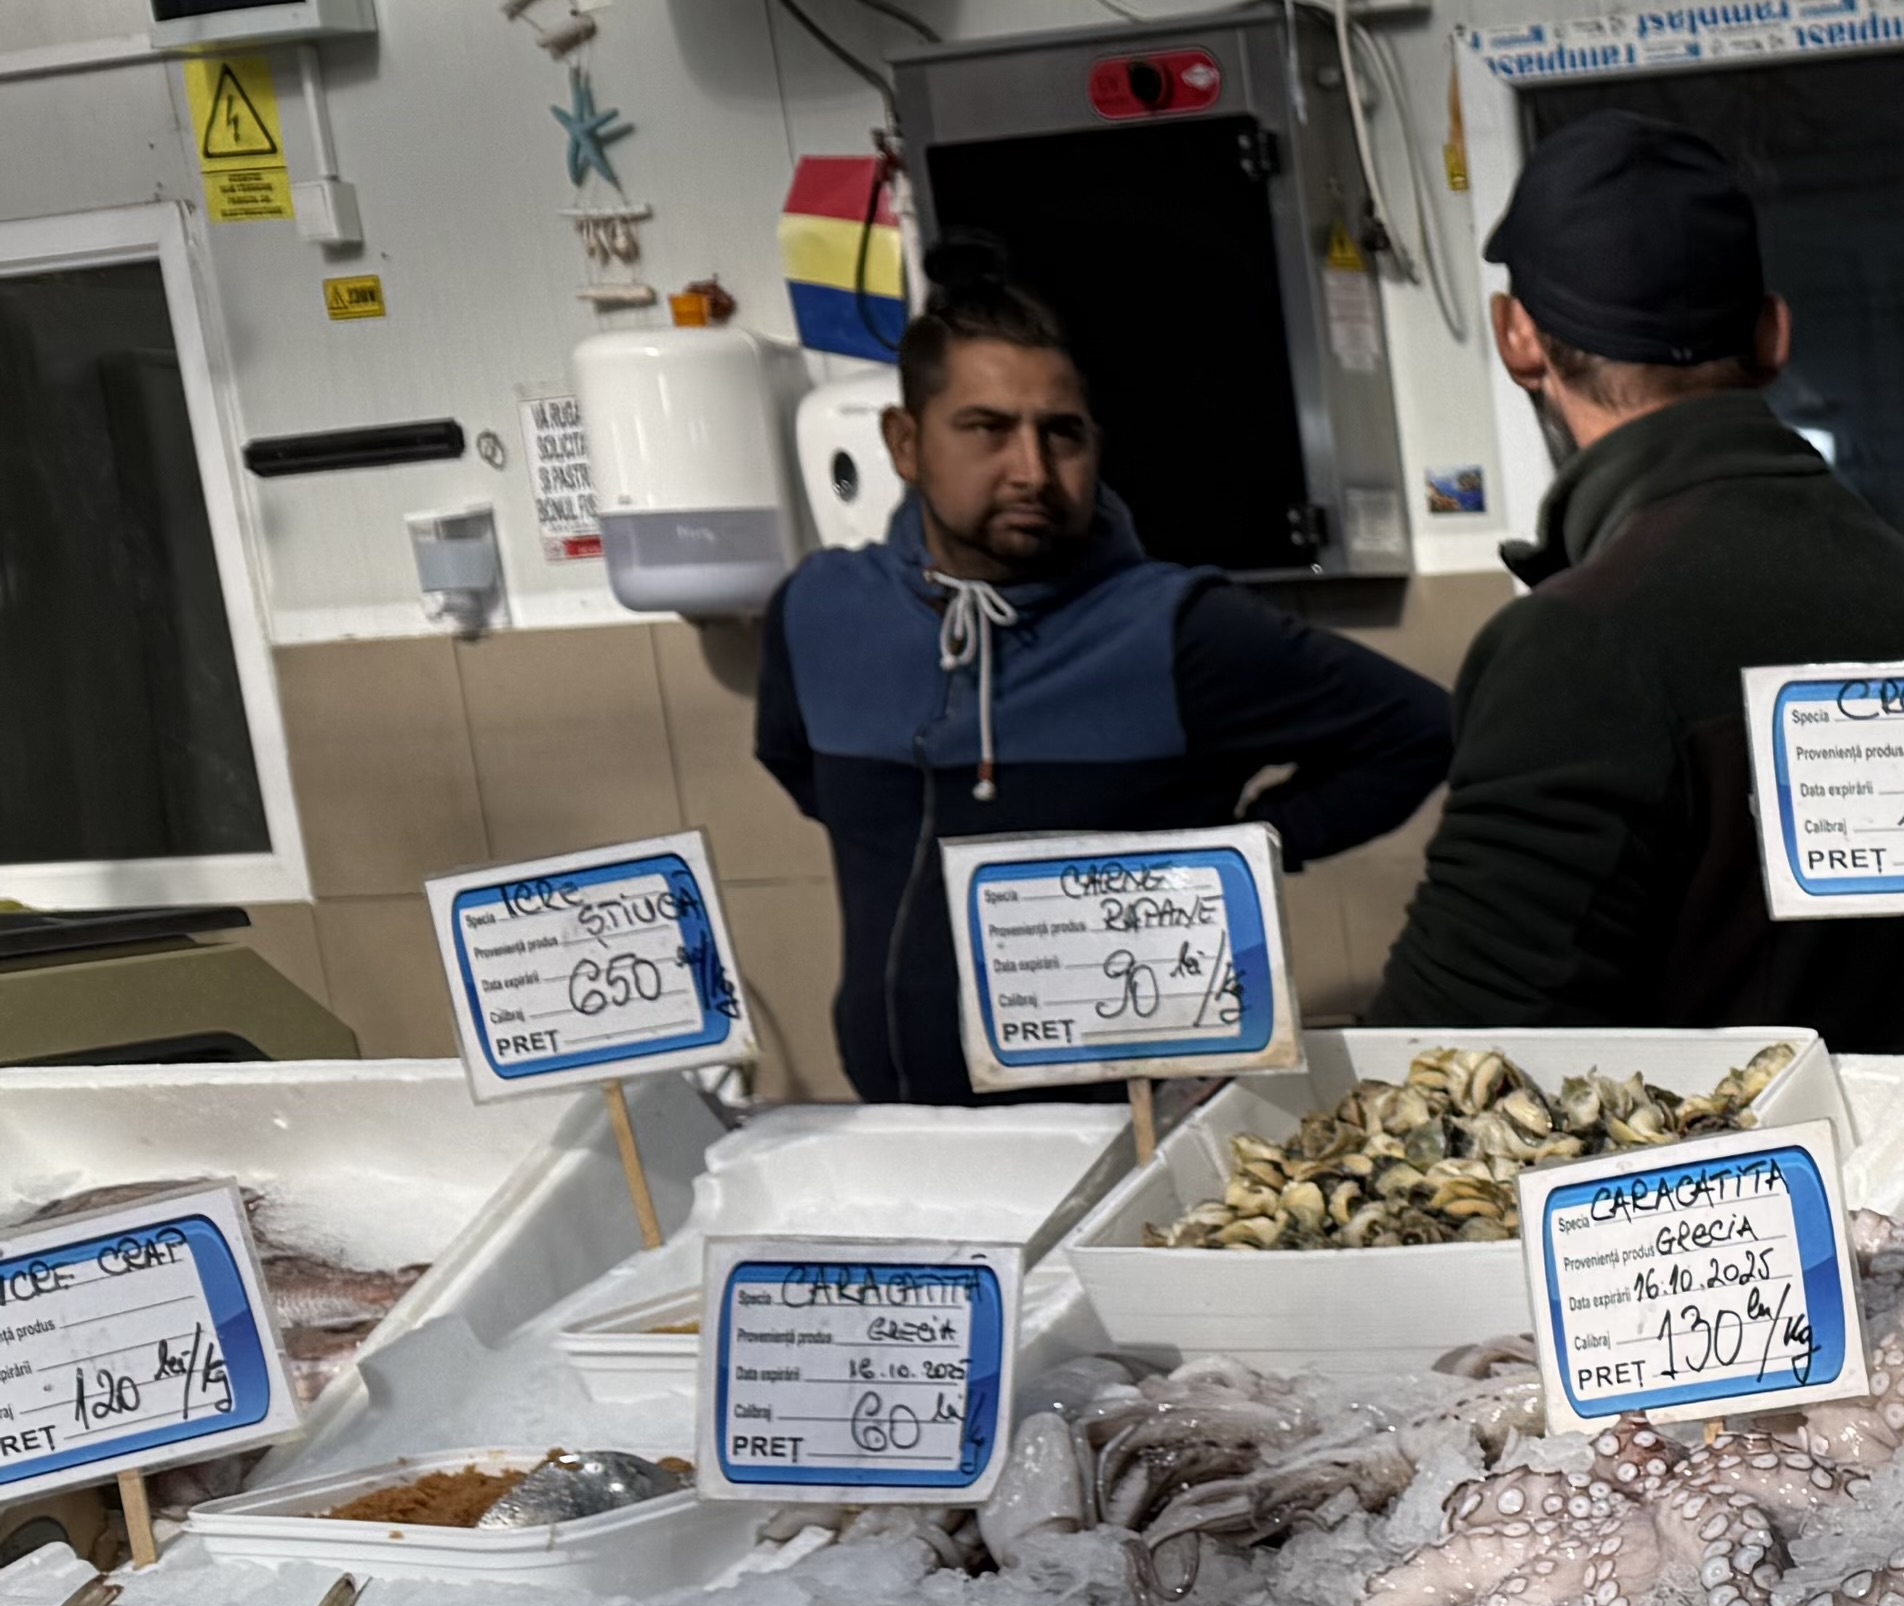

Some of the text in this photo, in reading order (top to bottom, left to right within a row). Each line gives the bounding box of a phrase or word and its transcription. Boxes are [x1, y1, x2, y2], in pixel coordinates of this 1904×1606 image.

[1792, 709, 1830, 726] Specia
[1797, 746, 1862, 762] Proveniență
[1866, 747, 1904, 760] produs
[1800, 783, 1873, 798] Data expirării
[1805, 820, 1847, 841] Calibraj
[1808, 848, 1887, 873] PREȚ
[984, 890, 1018, 903] Specia
[466, 914, 495, 928] Specia
[528, 936, 558, 953] produs
[994, 959, 1017, 972] Data
[482, 979, 503, 993] Data
[569, 954, 660, 1015] 650
[1095, 949, 1160, 1019] 90
[1000, 993, 1037, 1009] Calibraj
[490, 1011, 525, 1024] Calibraj
[1559, 1217, 1590, 1233] Specia
[1564, 1250, 1620, 1271] Proveniență
[1622, 1245, 1655, 1263] produs
[738, 1291, 772, 1305] Specia
[1569, 1296, 1591, 1311] Data
[1593, 1288, 1631, 1309] expirării
[17, 1319, 56, 1342] produs
[1574, 1332, 1610, 1350] Calibraj
[1578, 1306, 1743, 1390] PREȚ 130
[736, 1367, 758, 1380] Data
[0, 1367, 140, 1456] REȚ 120
[734, 1404, 772, 1422] Calibraj
[852, 1391, 920, 1452] 60
